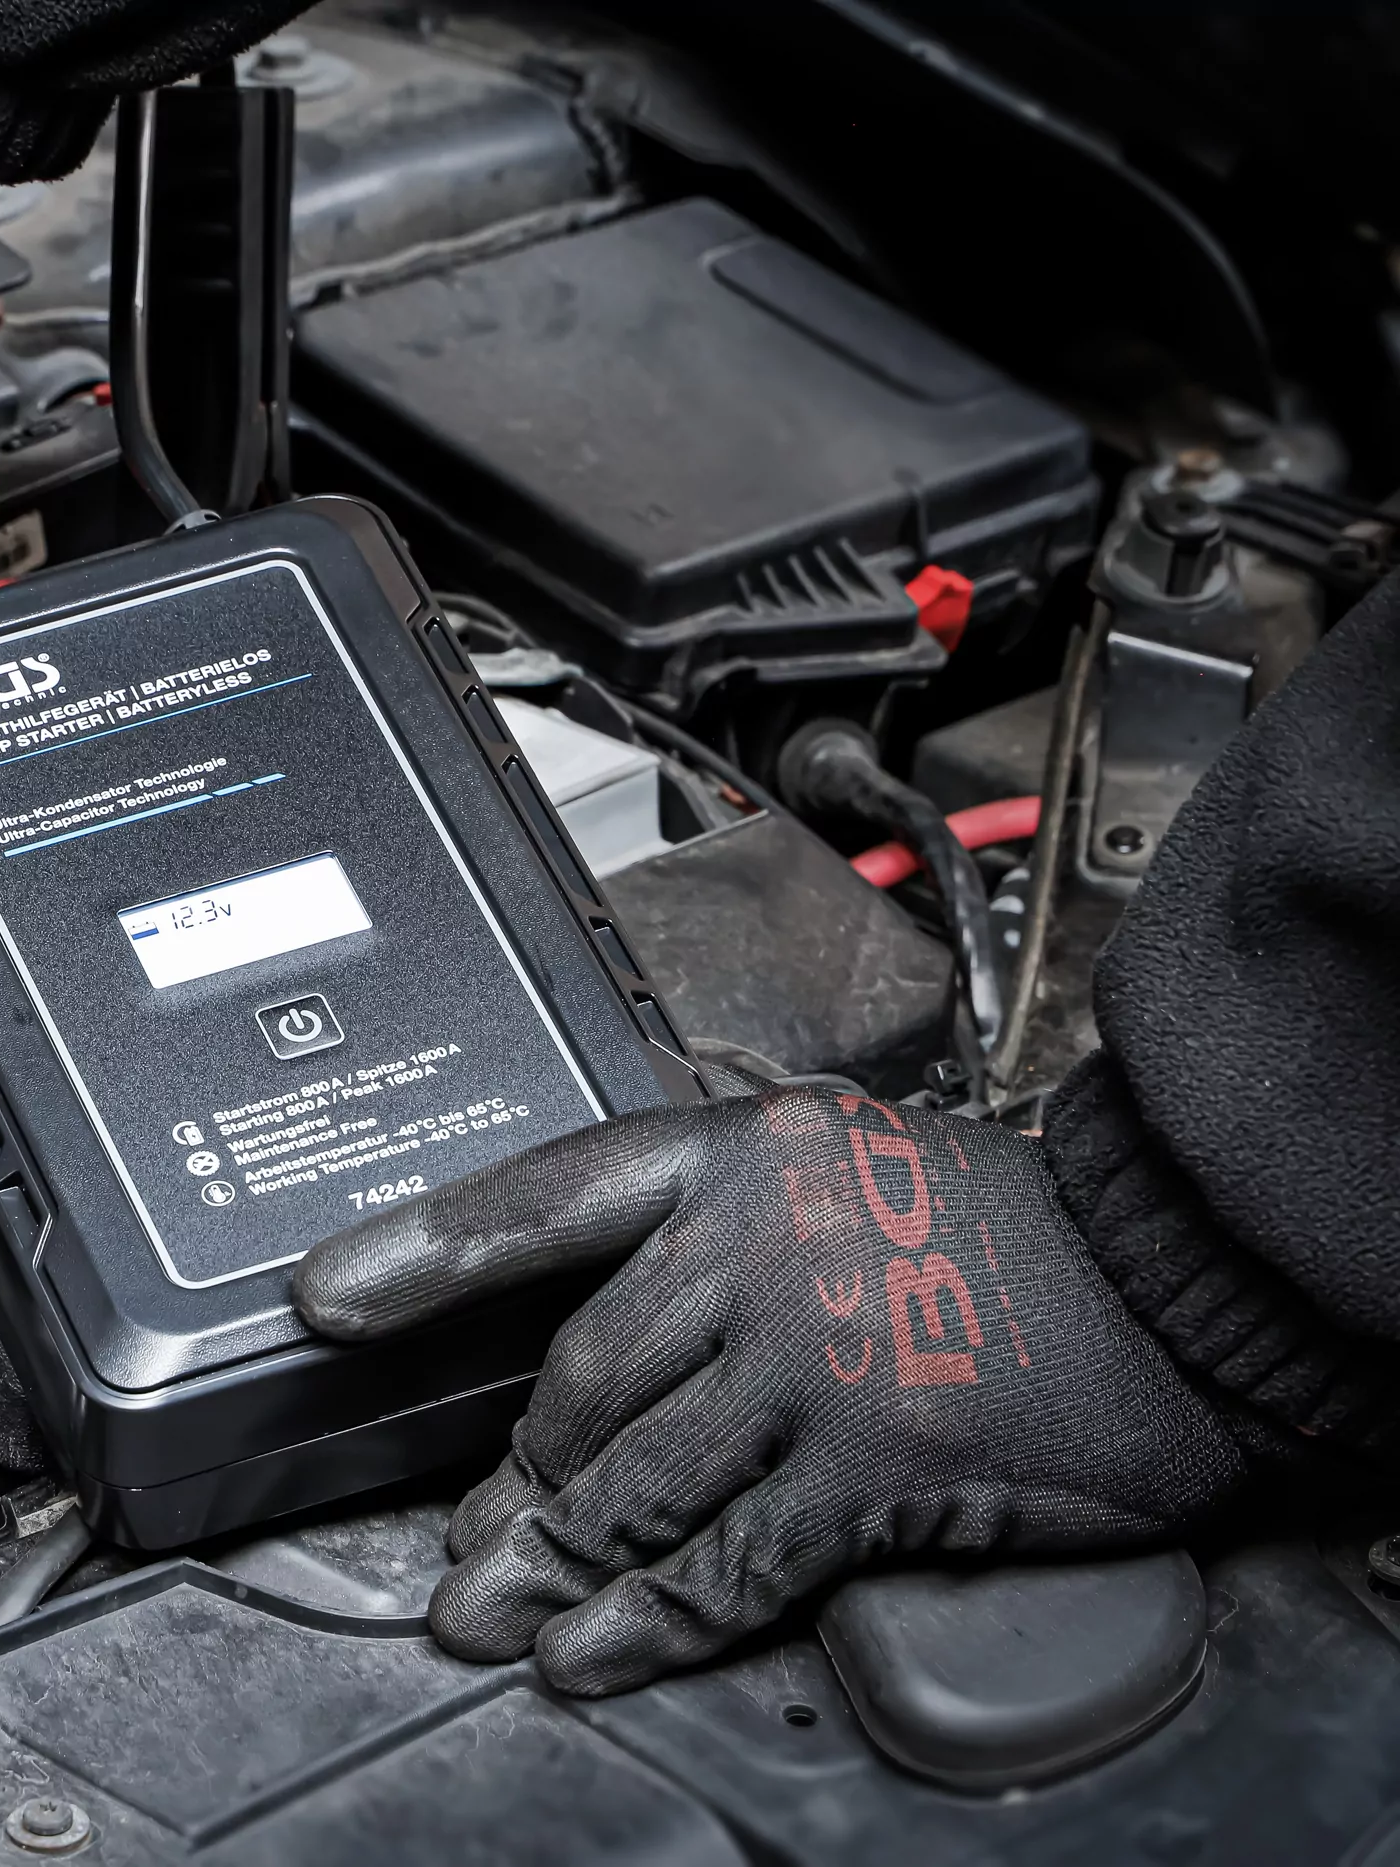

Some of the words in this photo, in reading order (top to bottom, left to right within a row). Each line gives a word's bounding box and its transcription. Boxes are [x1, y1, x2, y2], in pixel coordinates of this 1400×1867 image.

[141, 648, 272, 697] BATTERIELOS
[16, 712, 105, 749] STARTER
[118, 671, 253, 720] BATTERYLESS
[119, 777, 207, 812] Technology
[133, 756, 228, 794] Technologie
[212, 1092, 299, 1124] Startstrom
[356, 1060, 407, 1081] Spitze
[219, 1110, 285, 1136] Starting
[340, 1081, 384, 1101] Peak
[226, 1114, 331, 1153] Wartungsfrei
[233, 1128, 338, 1166] Maintenance
[340, 1117, 378, 1135] Free
[245, 1133, 389, 1184] Arbeitstemperatur
[392, 1117, 437, 1137] -40°C
[438, 1111, 466, 1126] bis
[466, 1097, 506, 1117] 65°C
[248, 1168, 318, 1196] Working
[318, 1138, 421, 1175] Temperature
[424, 1122, 469, 1143] -40°C
[470, 1118, 490, 1131] to
[490, 1105, 530, 1125] 65°C
[348, 1174, 428, 1210] 74242
